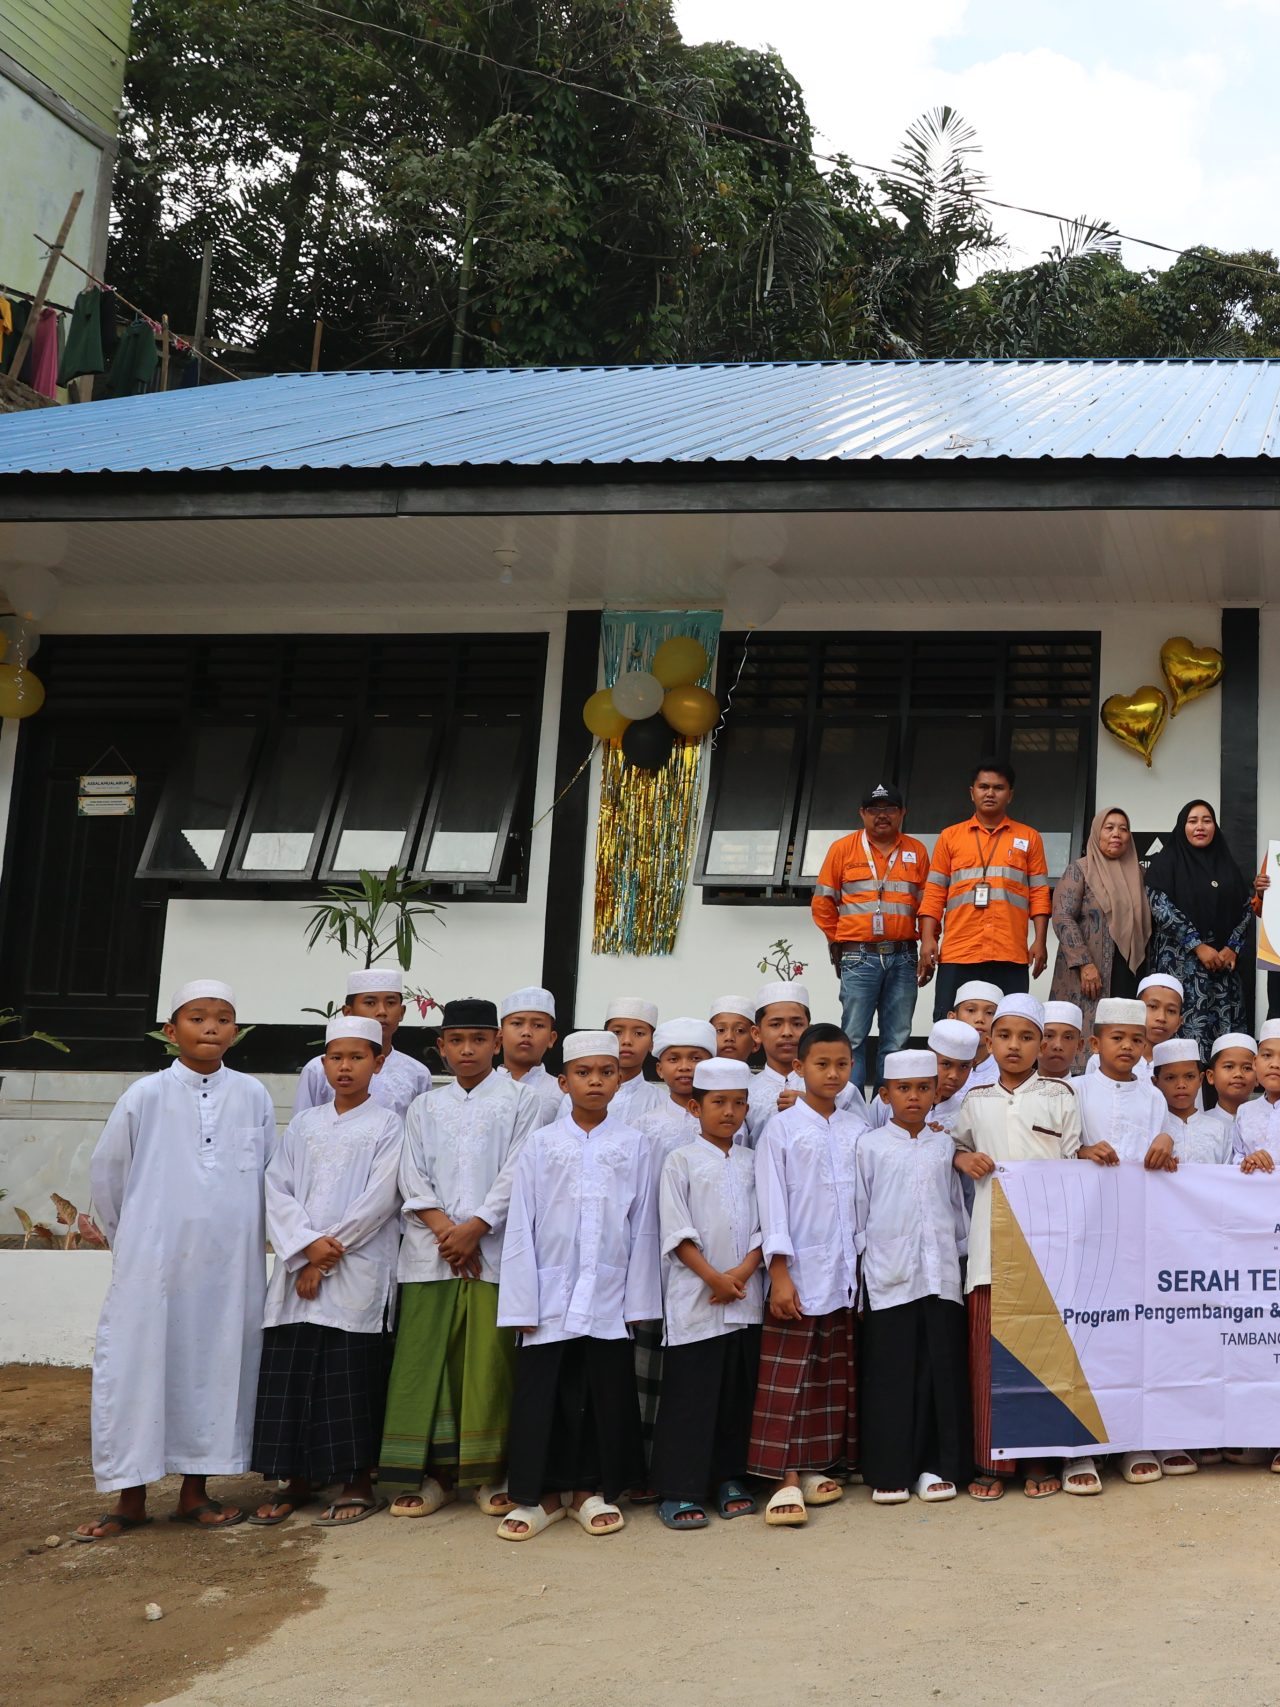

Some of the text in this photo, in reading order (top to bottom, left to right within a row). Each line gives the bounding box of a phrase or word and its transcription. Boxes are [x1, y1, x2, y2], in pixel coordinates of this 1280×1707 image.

[1157, 1269, 1239, 1292] SERAH
[1063, 1308, 1130, 1328] Program
[1134, 1303, 1264, 1325] Pengembangan
